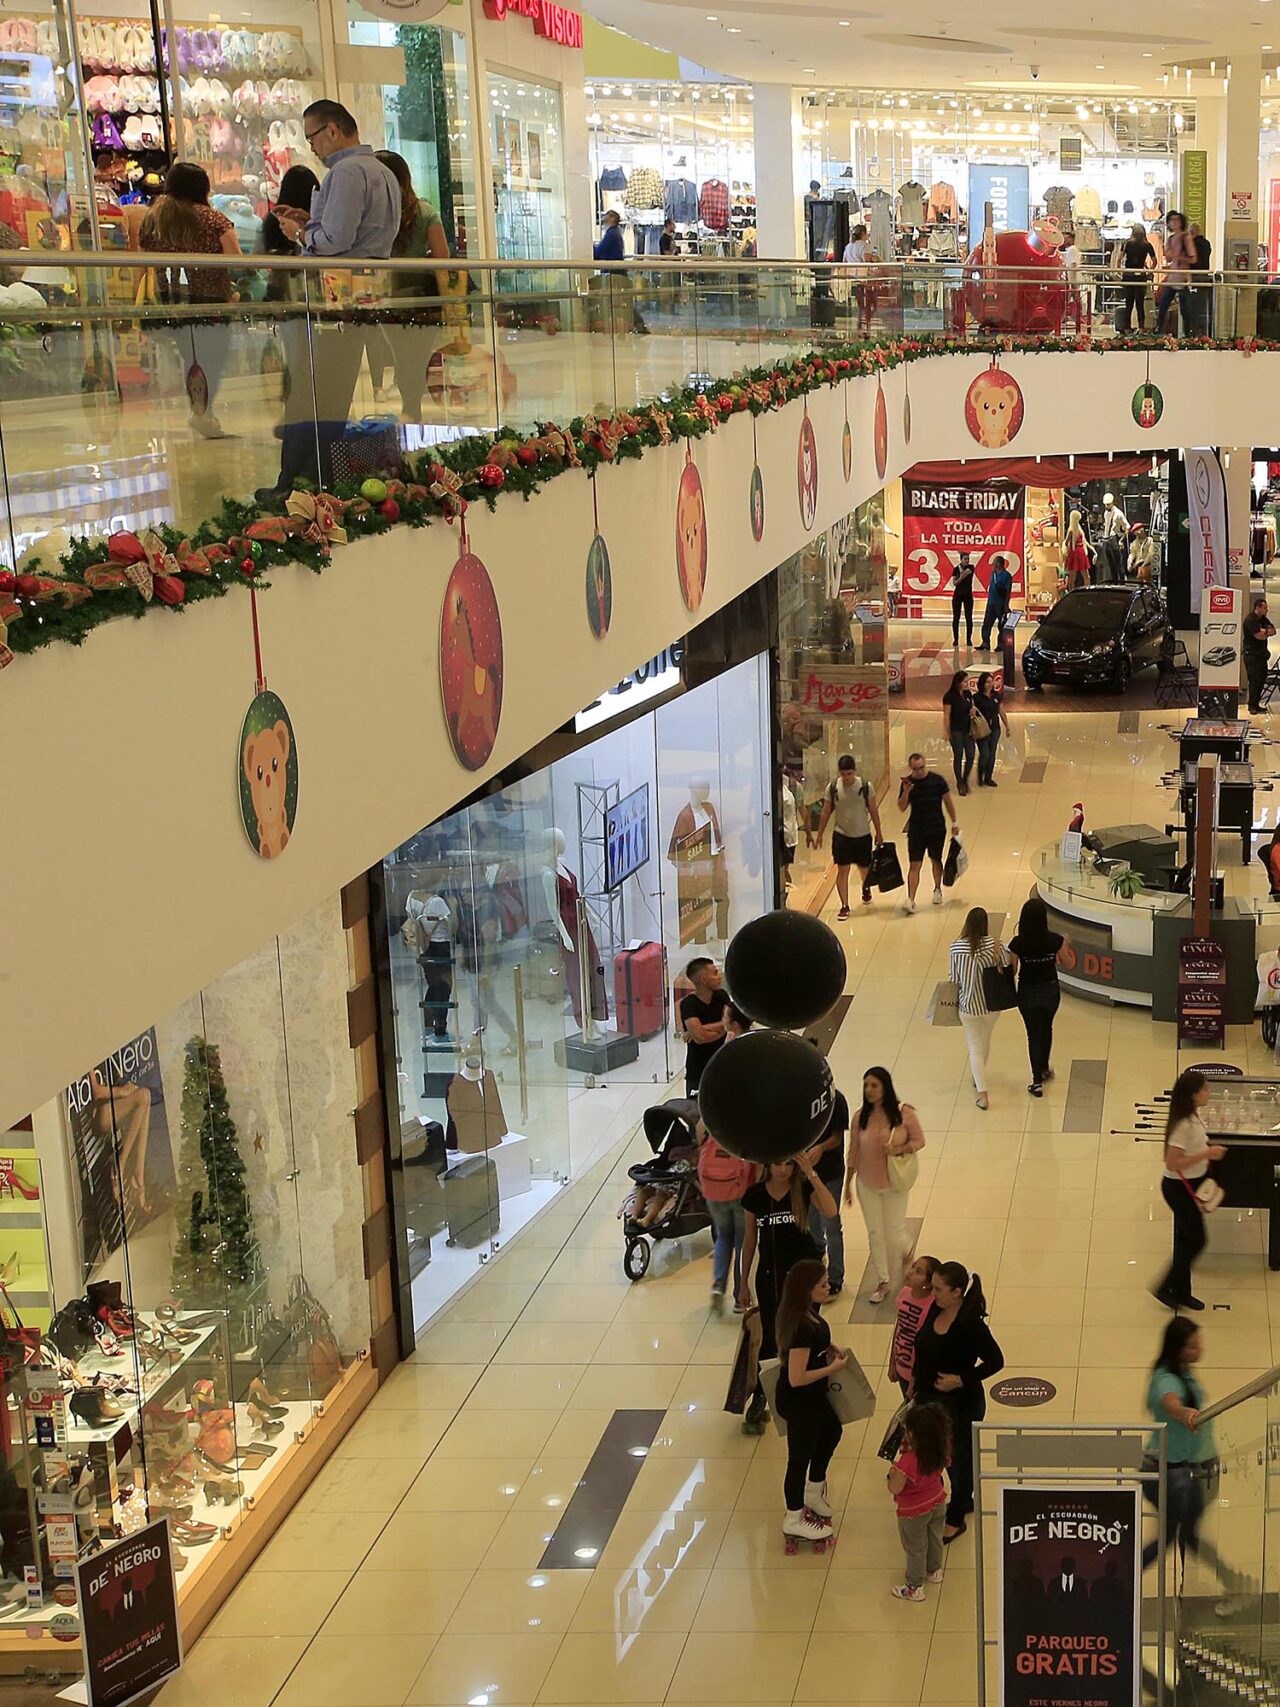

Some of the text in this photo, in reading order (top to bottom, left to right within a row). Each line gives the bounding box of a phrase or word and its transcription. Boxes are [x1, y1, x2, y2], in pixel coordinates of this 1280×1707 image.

[542, 0, 584, 48] VISION
[1187, 155, 1203, 184] CARGA
[911, 490, 1018, 511] BLACK FRIDAY
[921, 533, 1006, 545] LA TIENDA!!!
[944, 521, 982, 533] TODA
[687, 841, 703, 860] SALE
[1084, 953, 1112, 980] DE
[106, 1036, 153, 1086] Nero
[810, 1090, 828, 1119] DE
[769, 1214, 797, 1226] NEGR
[1050, 1511, 1098, 1521] ESCUADRÓN
[1009, 1521, 1121, 1546] DE NEGRO
[89, 1546, 161, 1596] DE NEGRO
[1026, 1635, 1109, 1650] PARQUEO
[1016, 1652, 1118, 1676] GRATIS
